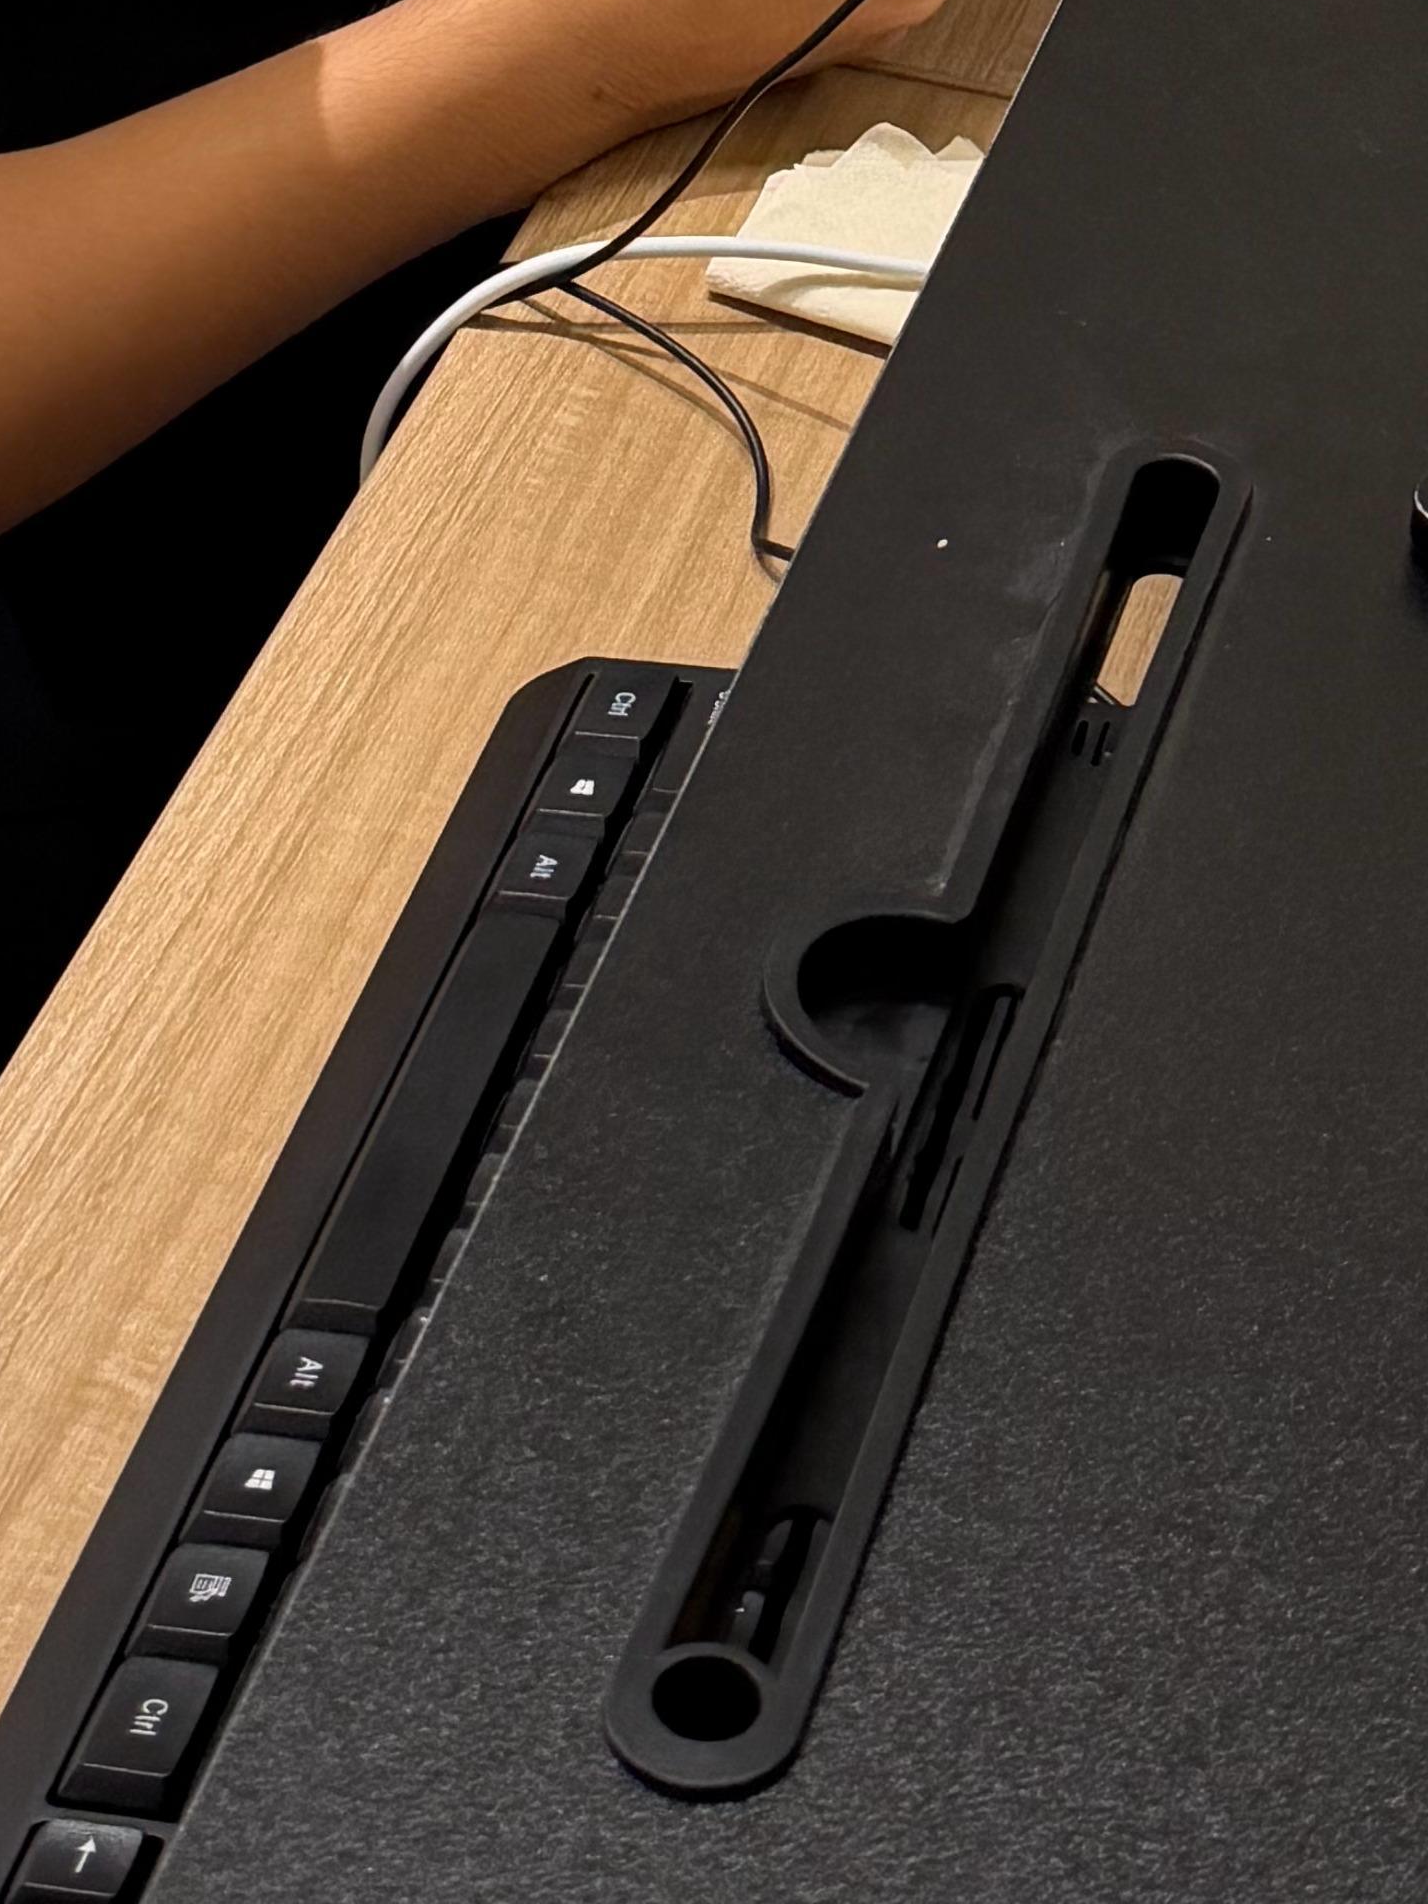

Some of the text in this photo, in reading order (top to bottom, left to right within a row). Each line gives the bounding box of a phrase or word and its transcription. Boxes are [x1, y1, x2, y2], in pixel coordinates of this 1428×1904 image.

[607, 691, 637, 718] Ctrl
[530, 854, 559, 879] Alt
[289, 1355, 324, 1389] Alt
[128, 1698, 169, 1737] Ctrl
